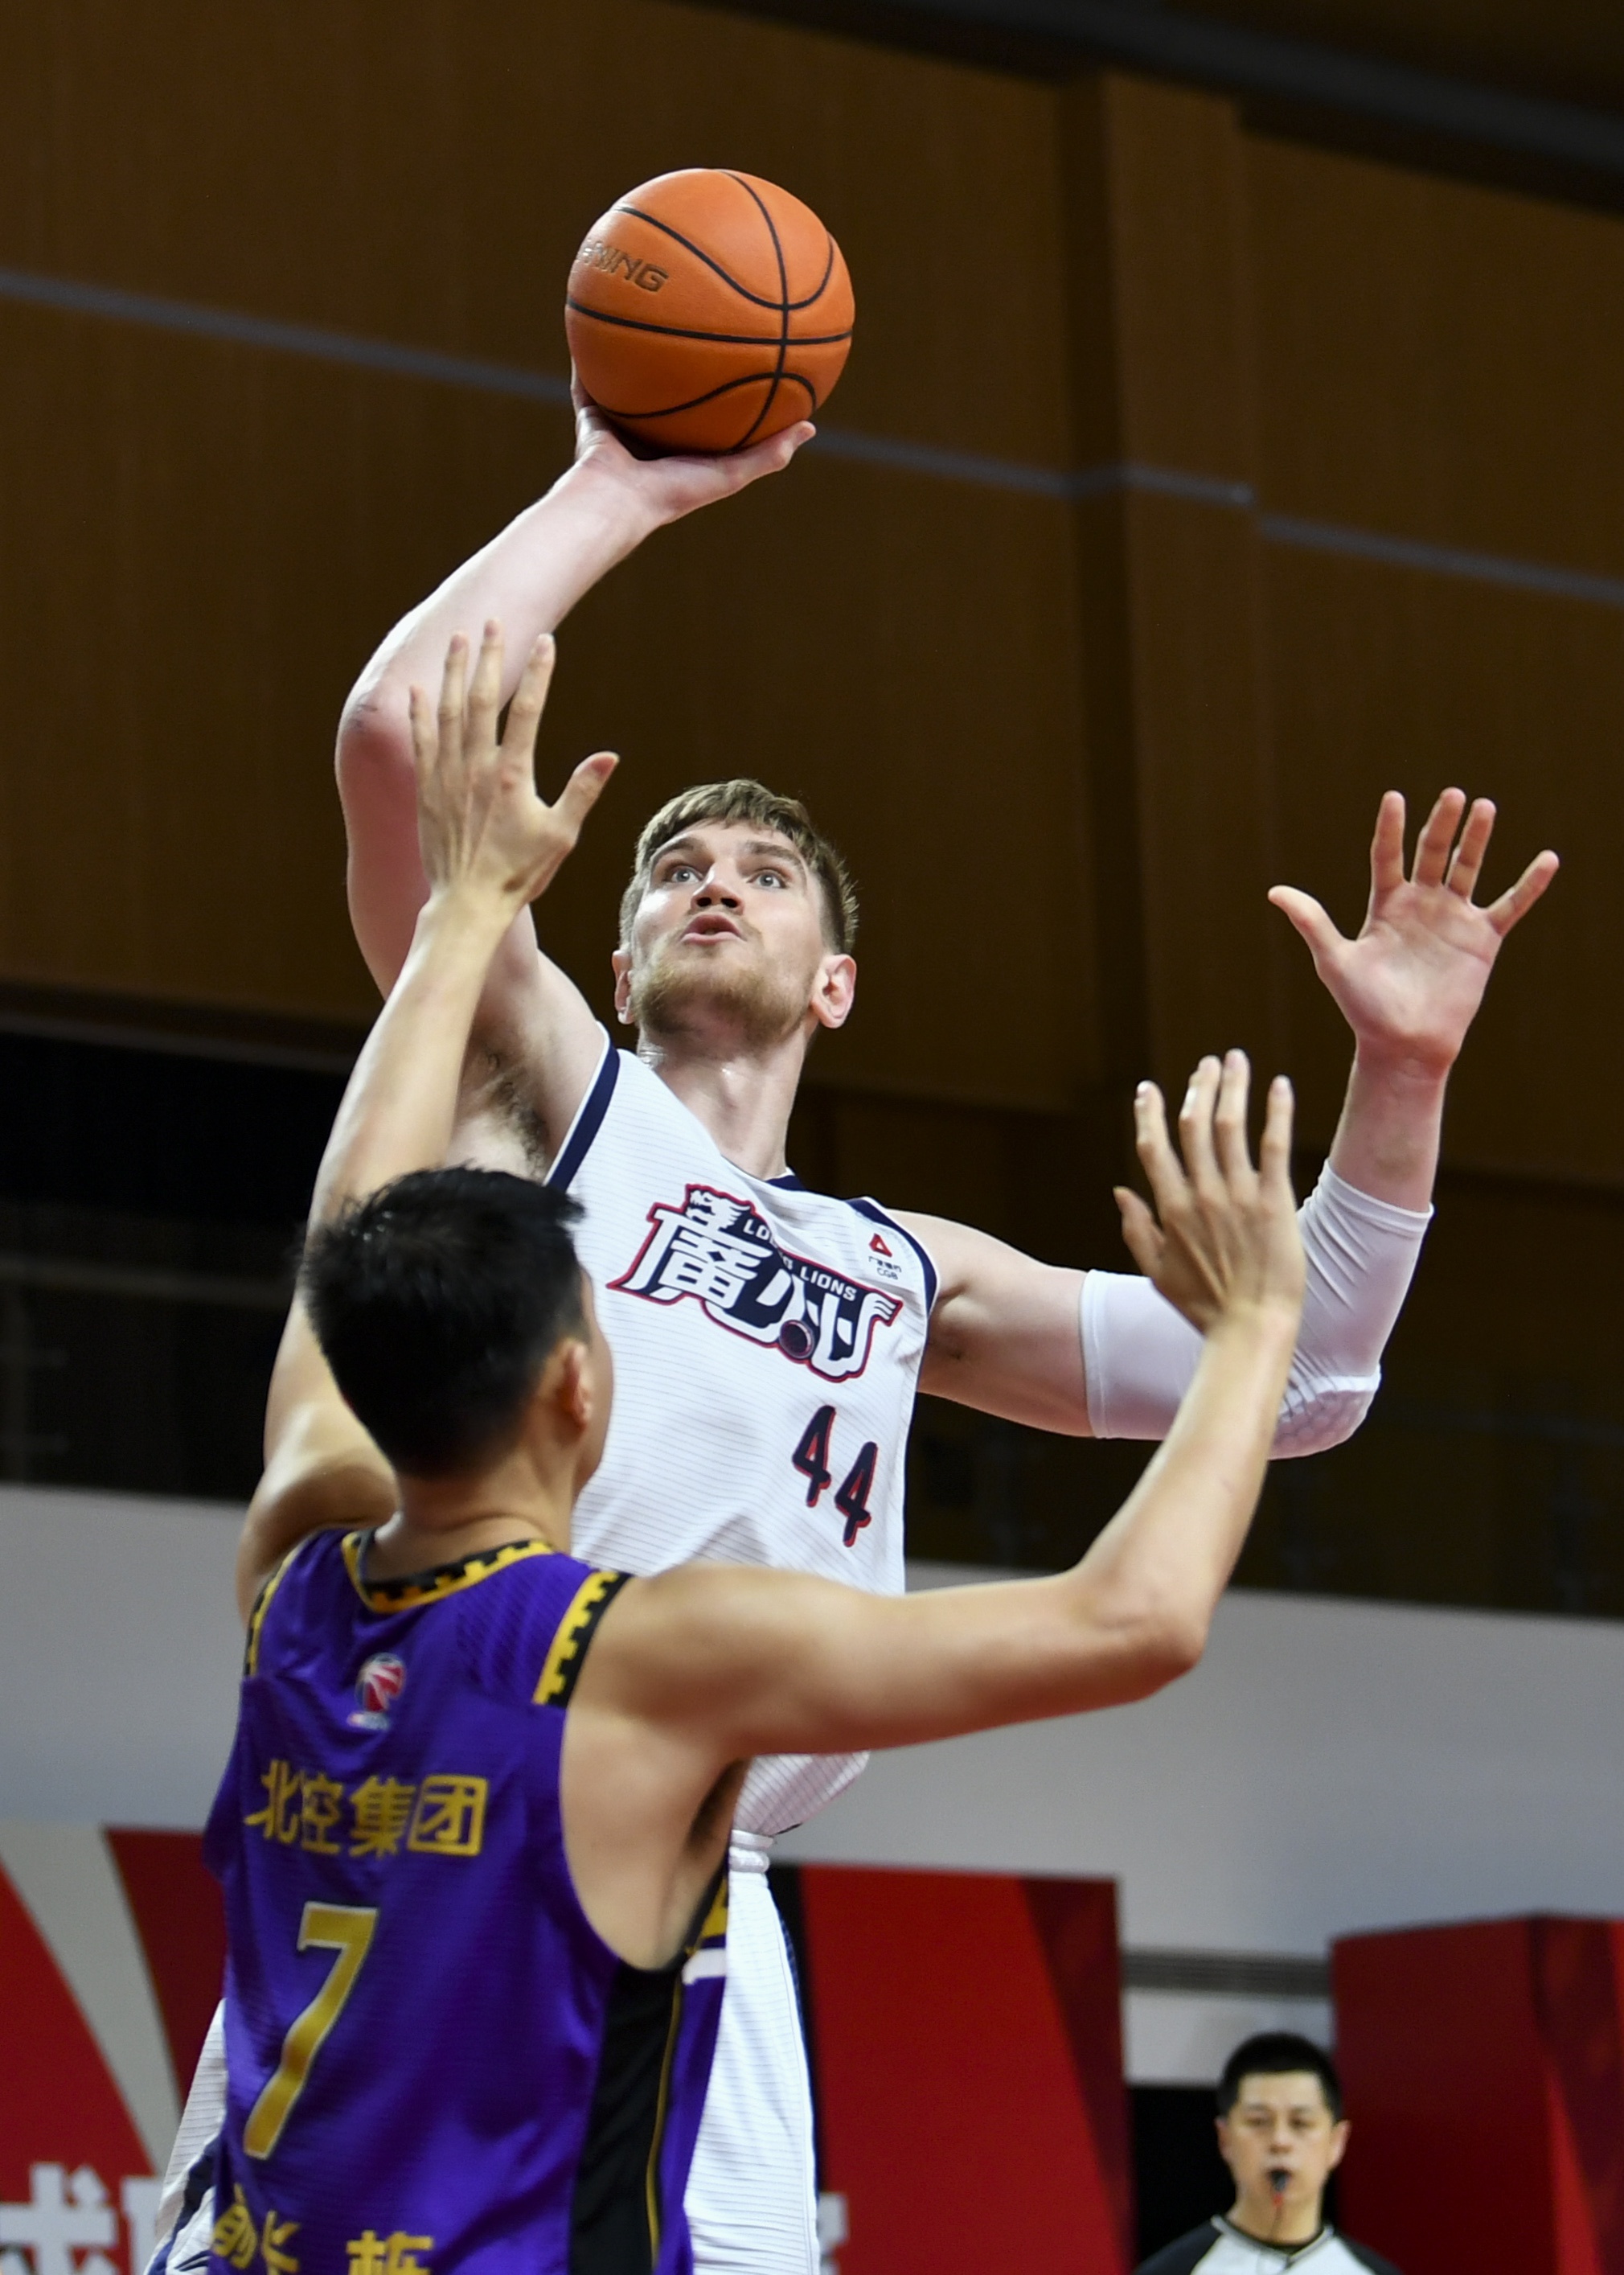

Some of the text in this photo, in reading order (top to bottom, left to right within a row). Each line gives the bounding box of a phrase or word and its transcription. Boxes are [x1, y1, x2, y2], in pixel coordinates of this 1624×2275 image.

[800, 1266, 857, 1301] LIONS
[792, 1405, 878, 1547] 44
[244, 1901, 379, 2160] 7
